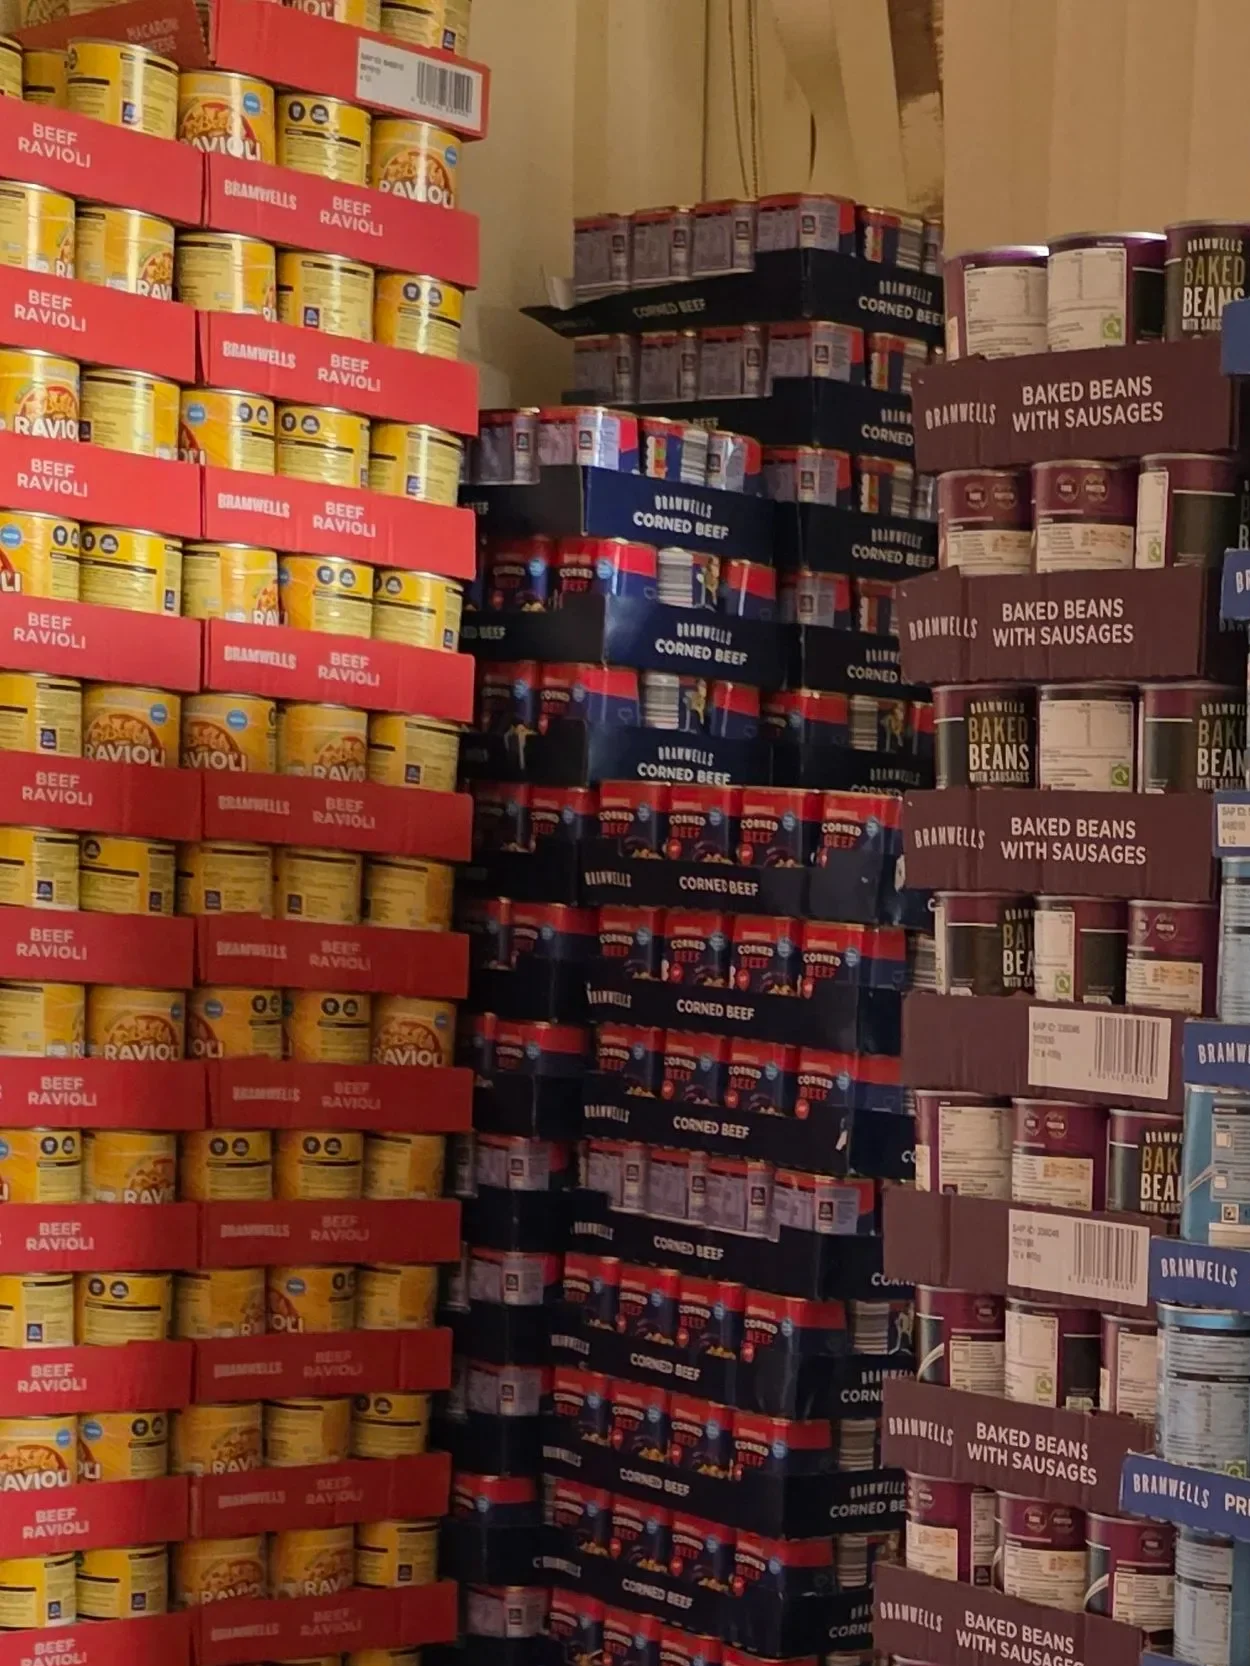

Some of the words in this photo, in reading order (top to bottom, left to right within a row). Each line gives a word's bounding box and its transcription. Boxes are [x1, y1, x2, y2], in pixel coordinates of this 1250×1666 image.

[32, 123, 77, 145] BEEF
[18, 137, 90, 169] RAVIOLI
[224, 180, 297, 210] BRAMWELLS
[332, 195, 371, 217] BEEF
[320, 210, 383, 237] RAVIOLI
[1187, 237, 1243, 253] BRAMWELLS
[1185, 257, 1245, 286] BAKED
[28, 289, 73, 311] BEEF
[680, 299, 706, 314] BEEF
[14, 304, 87, 332] RAVIOLI
[223, 341, 296, 369] BRAMWELLS
[330, 354, 370, 374] BEEF
[318, 366, 381, 393] RAVIOLI
[1023, 381, 1084, 406] BAKED
[1089, 376, 1152, 399] BEANS
[925, 403, 996, 430] BRAMWELLS
[1012, 410, 1059, 433] WITH
[1065, 402, 1164, 429] SAUSAGES
[654, 495, 712, 519] BRAMWELLS
[633, 511, 692, 535] CORNED
[695, 523, 729, 541] BEEF
[28, 612, 72, 631] BEEF
[13, 627, 87, 650] RAVIOLI
[676, 623, 732, 646] BRAMWELLS
[224, 645, 297, 670] BRAMWELLS
[330, 652, 370, 670] BEEF
[655, 639, 711, 661] CORNED
[715, 649, 748, 666] BEEF
[318, 667, 381, 687] RAVIOLI
[970, 702, 1024, 715] BRAMWELLS
[969, 717, 1028, 743] BAKED
[658, 746, 714, 767] BRAMWELLS
[969, 745, 1030, 770] BEANS
[637, 762, 694, 782] CORNED
[697, 770, 731, 786] BEEF
[969, 771, 988, 783] WITH
[991, 770, 1030, 783] SAUSAGES
[822, 822, 862, 837] CORNED
[914, 829, 985, 850] BRAMWELLS
[1011, 817, 1071, 837] BAKED
[1076, 819, 1136, 839] BEANS
[1001, 840, 1047, 860] WITH
[1052, 843, 1146, 865] SAUSAGES
[585, 870, 632, 889] BRAMWELLS
[679, 876, 728, 893] CORNED
[729, 880, 759, 897] BEEF
[677, 1000, 723, 1017] CORNED
[726, 1004, 755, 1021] BEEF
[40, 1076, 83, 1092] BEEF
[27, 1091, 97, 1108] RAVIOLI
[584, 1105, 630, 1123] BRAMWELLS
[673, 1116, 718, 1135] CORNED
[721, 1121, 750, 1139] BEEF
[1161, 1258, 1238, 1288] BRAMWELLS
[630, 1353, 671, 1374] CORNED
[674, 1360, 700, 1380] BEEF
[888, 1417, 953, 1446] BRAMWELLS
[977, 1423, 1031, 1449] BAKED
[1035, 1435, 1089, 1461] BEANS
[967, 1442, 1008, 1468] WITH
[1011, 1451, 1097, 1486] SAUSAGES
[36, 1508, 76, 1524] BEEF
[23, 1521, 89, 1540] RAVIOLI
